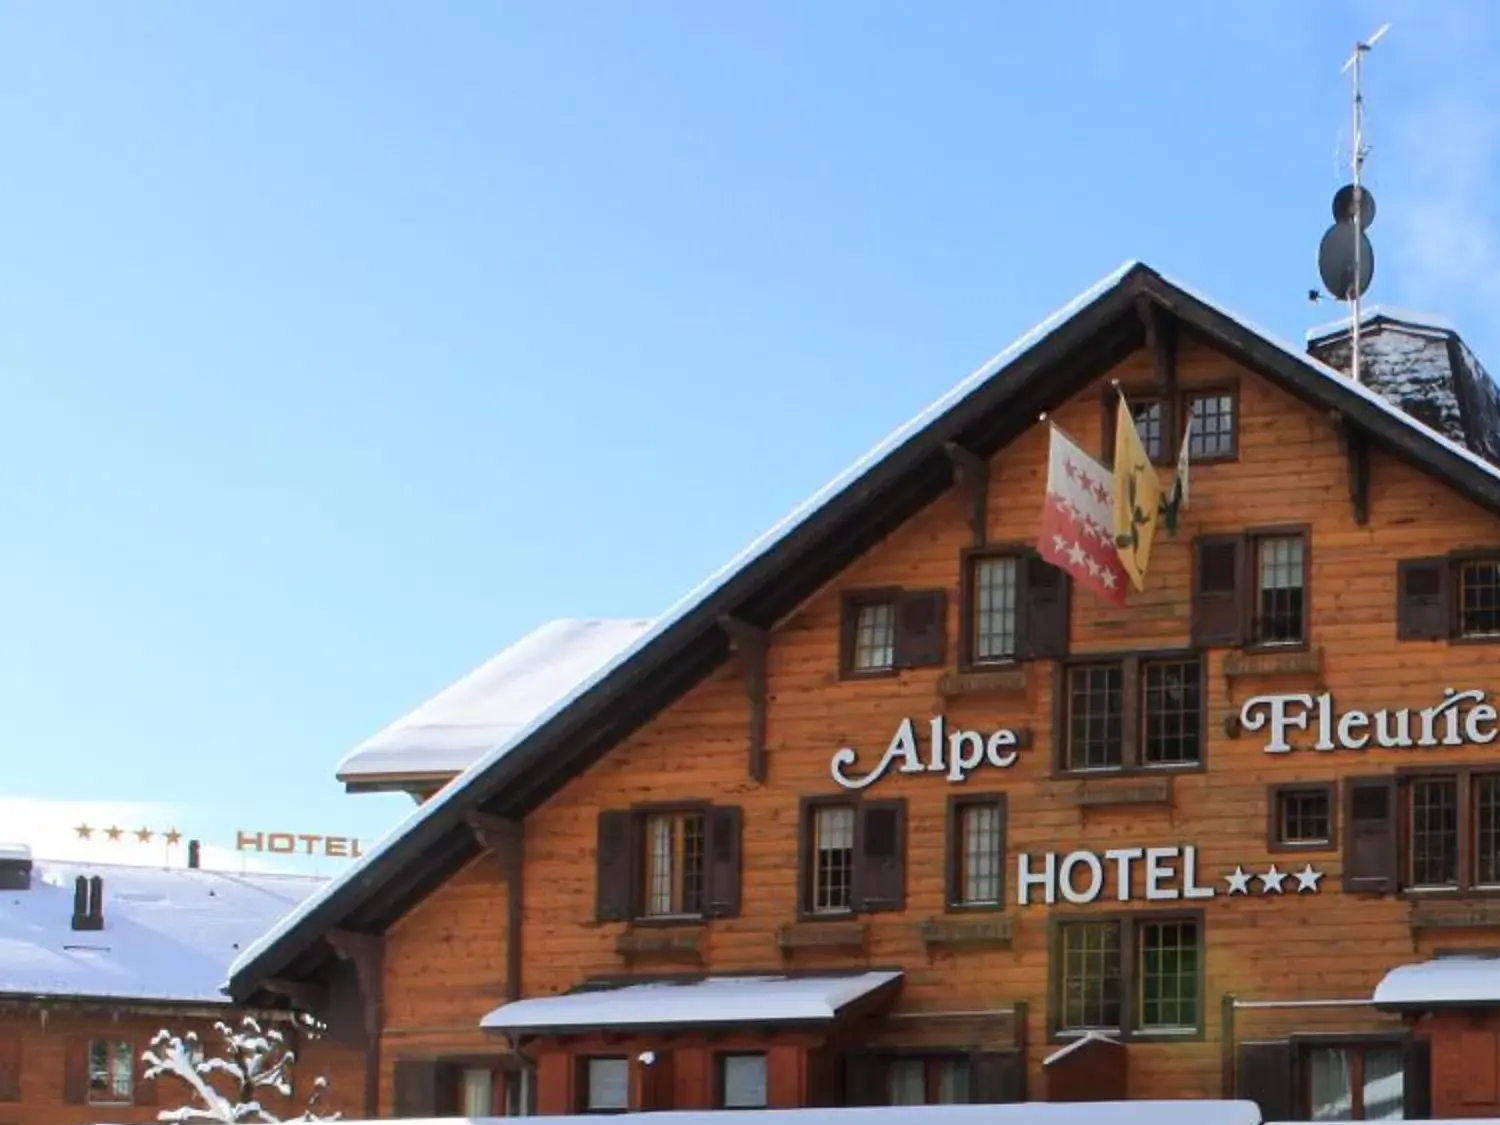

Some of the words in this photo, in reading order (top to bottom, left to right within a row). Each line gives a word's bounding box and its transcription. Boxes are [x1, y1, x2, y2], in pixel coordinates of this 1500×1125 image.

[831, 713, 1017, 789] Alpe
[1240, 687, 1498, 753] Fleurie
[236, 830, 363, 858] HOTEL
[1017, 845, 1215, 905] HOTEL
